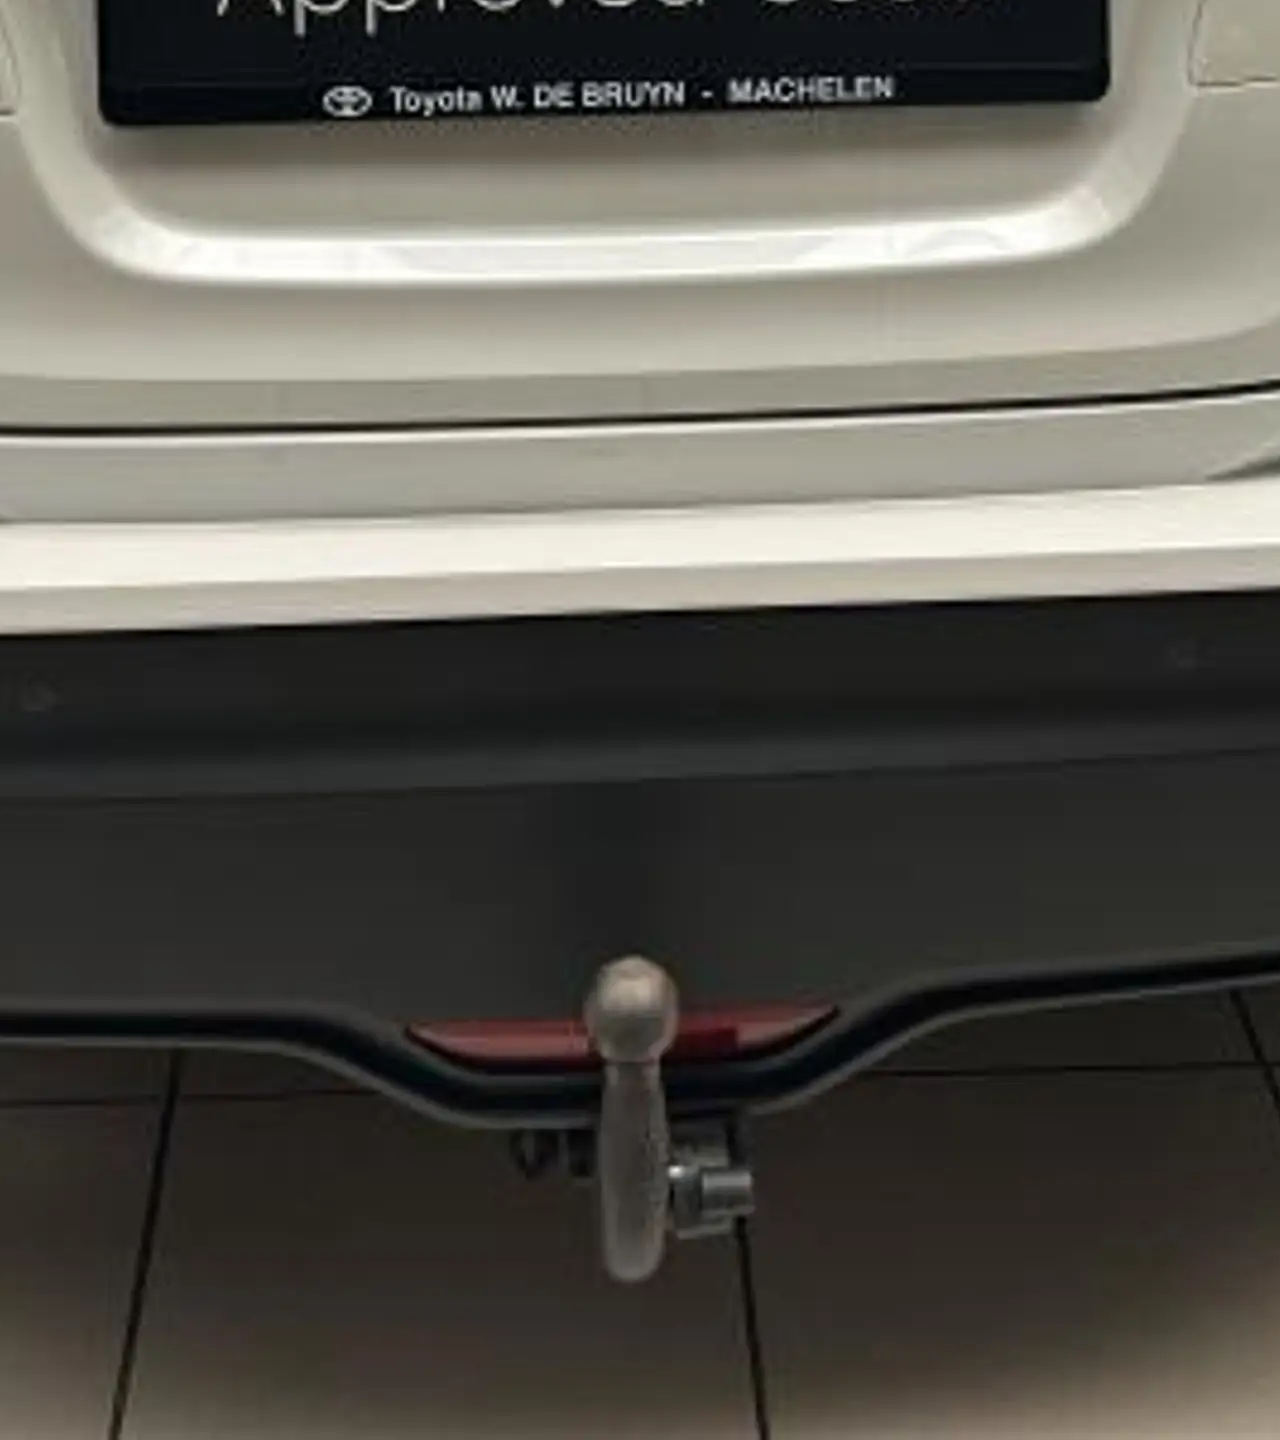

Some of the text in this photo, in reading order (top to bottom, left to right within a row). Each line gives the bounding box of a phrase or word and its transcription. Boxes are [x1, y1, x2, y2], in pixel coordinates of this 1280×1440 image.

[390, 85, 482, 118] Toyota
[489, 85, 525, 109] W.
[532, 82, 574, 109] DE
[581, 79, 686, 109] BRUYN
[727, 76, 894, 104] MACHELEN
